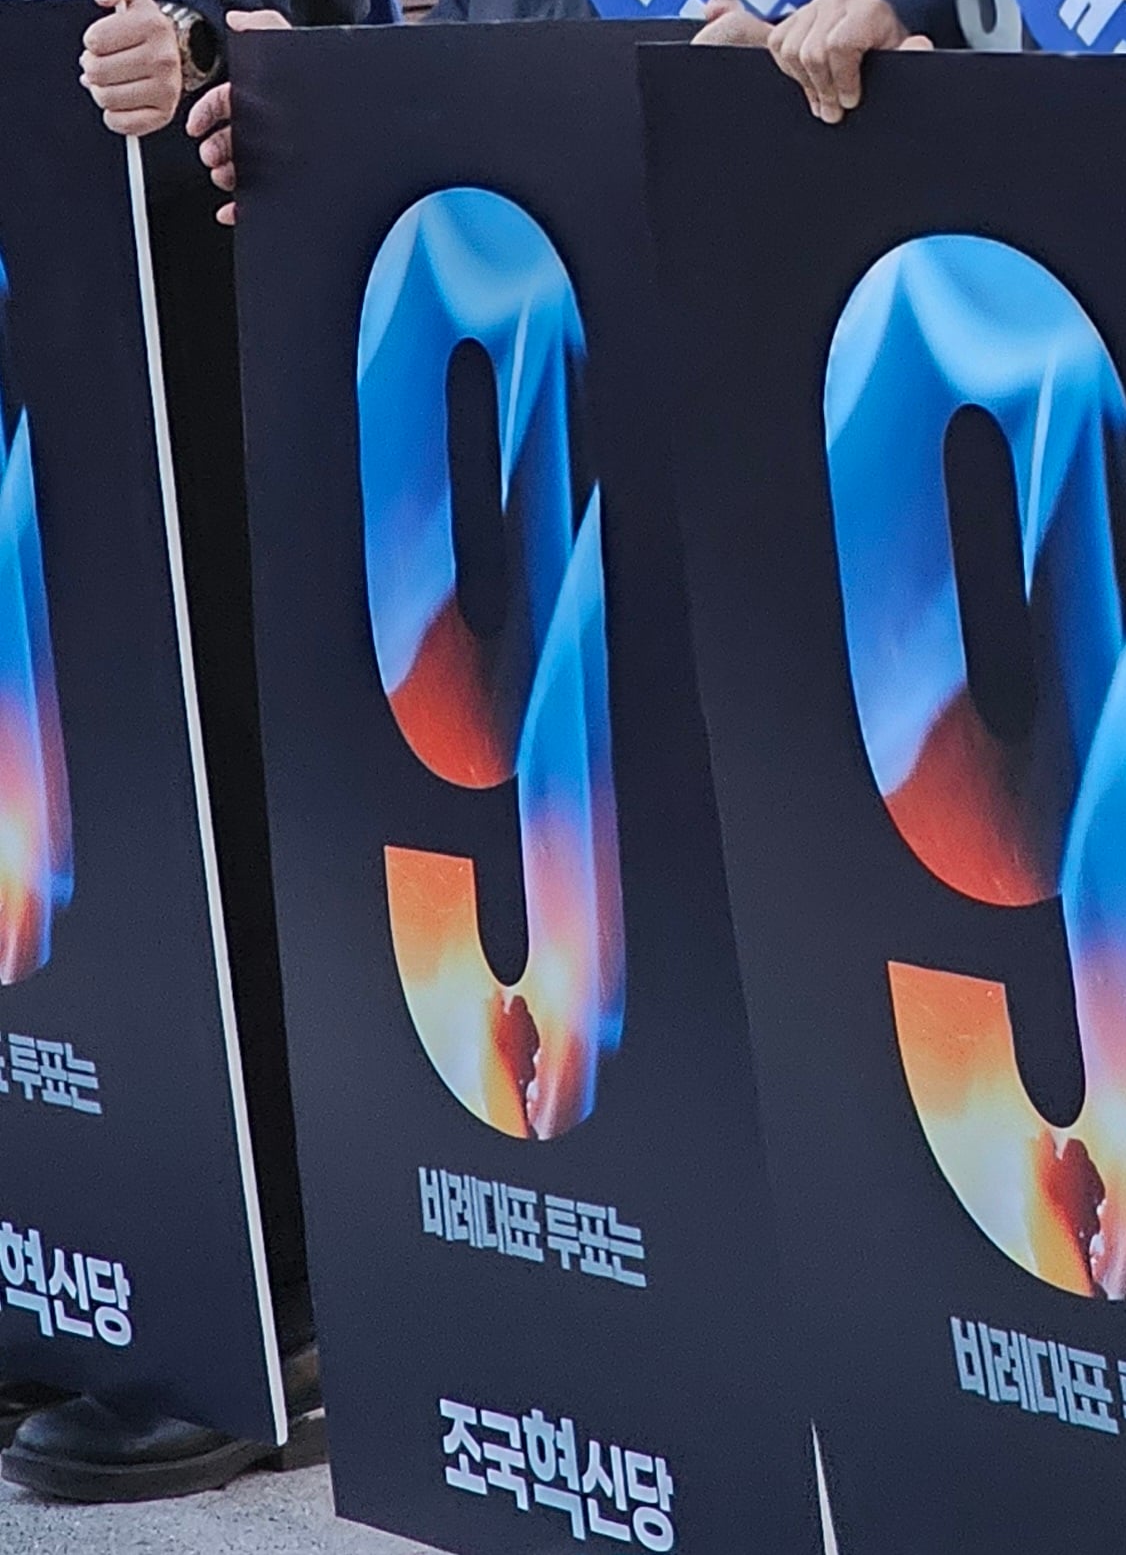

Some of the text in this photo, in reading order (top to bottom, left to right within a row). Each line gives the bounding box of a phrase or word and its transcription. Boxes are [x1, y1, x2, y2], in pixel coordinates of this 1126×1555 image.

[357, 188, 627, 1141] 9
[418, 1166, 648, 1288] 비례대표 투표는
[949, 1316, 1120, 1436] 비례대표
[438, 1397, 675, 1553] 조국혁신당
